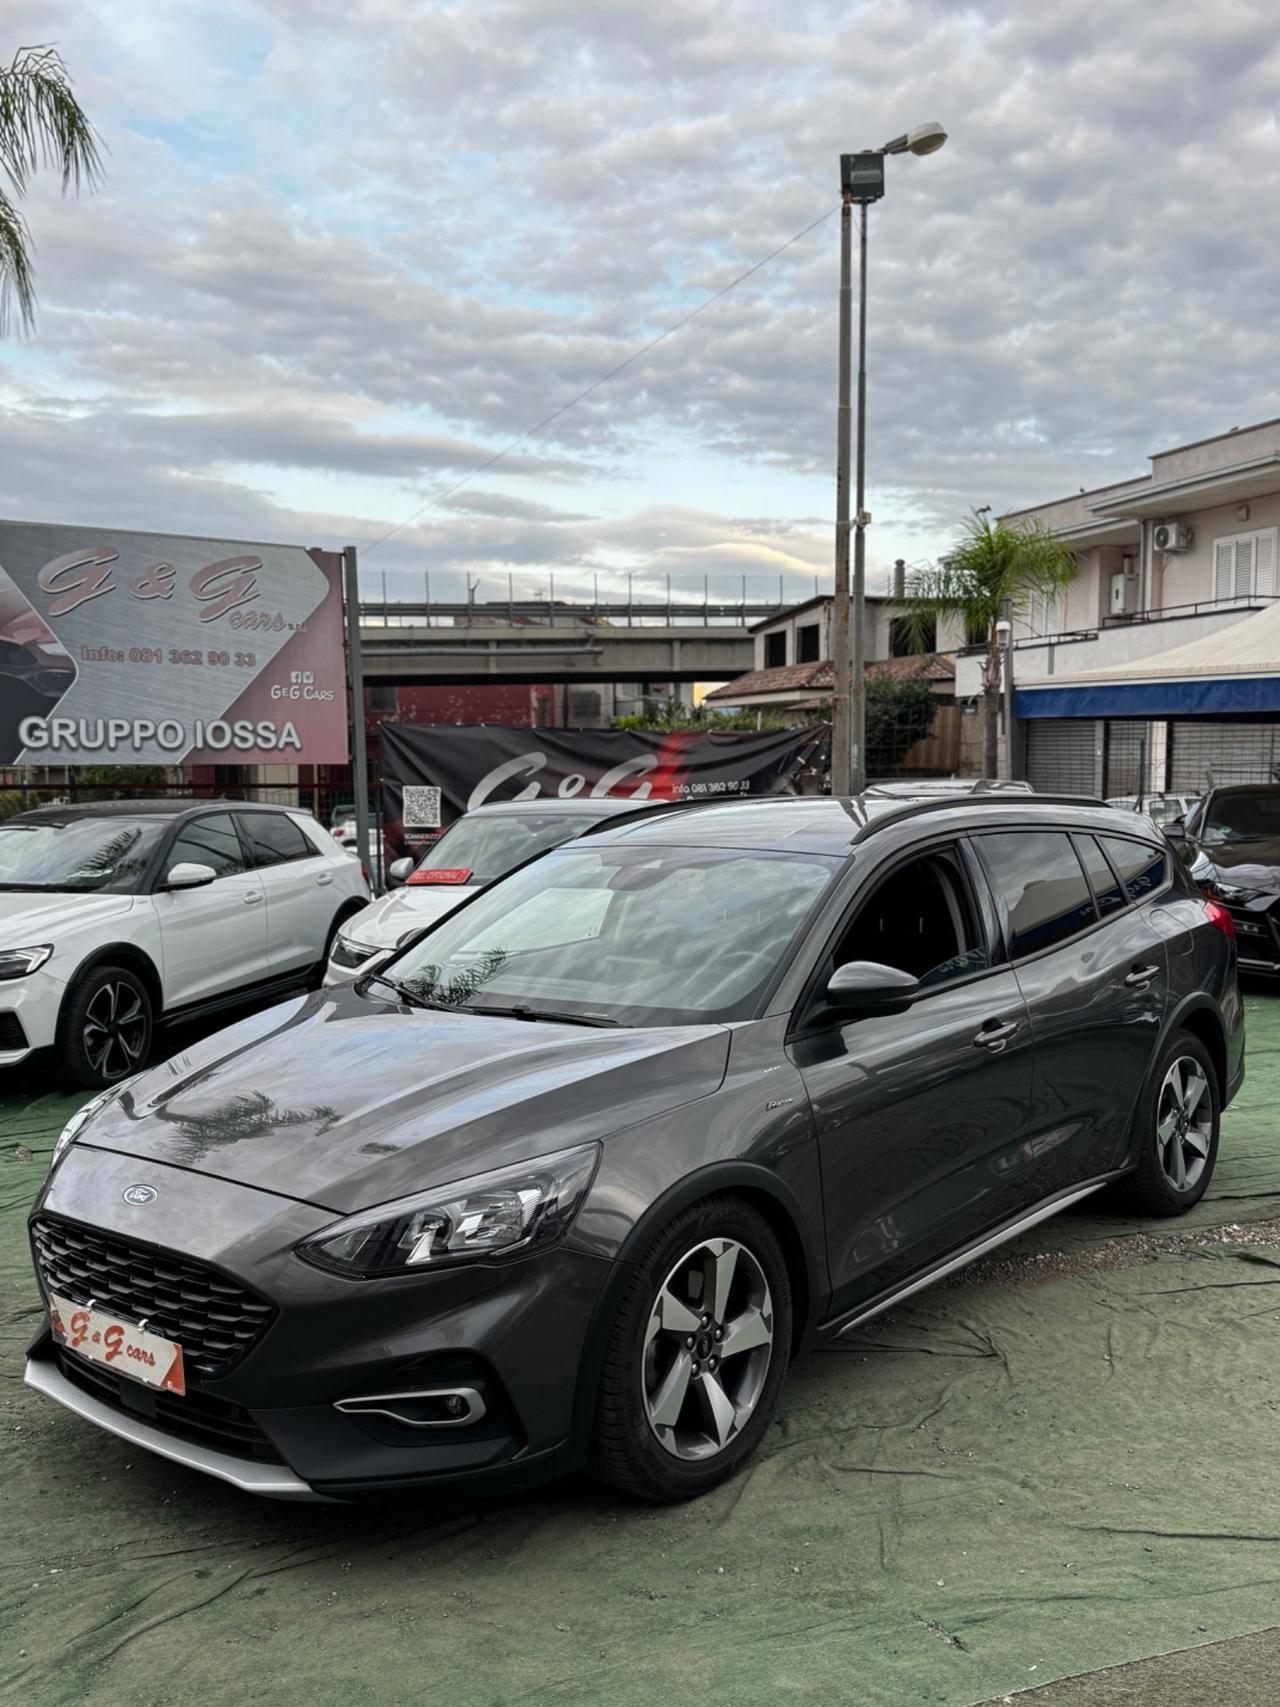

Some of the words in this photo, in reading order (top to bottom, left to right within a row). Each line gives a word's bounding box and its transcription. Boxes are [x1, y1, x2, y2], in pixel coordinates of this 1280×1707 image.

[37, 546, 119, 617] G
[129, 561, 176, 600] &
[189, 555, 263, 623] G
[227, 609, 286, 632] cars
[81, 645, 125, 663] Info:
[129, 647, 163, 664] 081
[207, 650, 230, 666] 90
[234, 651, 257, 668] 33
[18, 716, 184, 750] GRUPPO
[194, 719, 302, 750] IOSSA
[70, 1311, 91, 1347] G
[103, 1325, 126, 1363] G
[126, 1344, 157, 1367] cars
